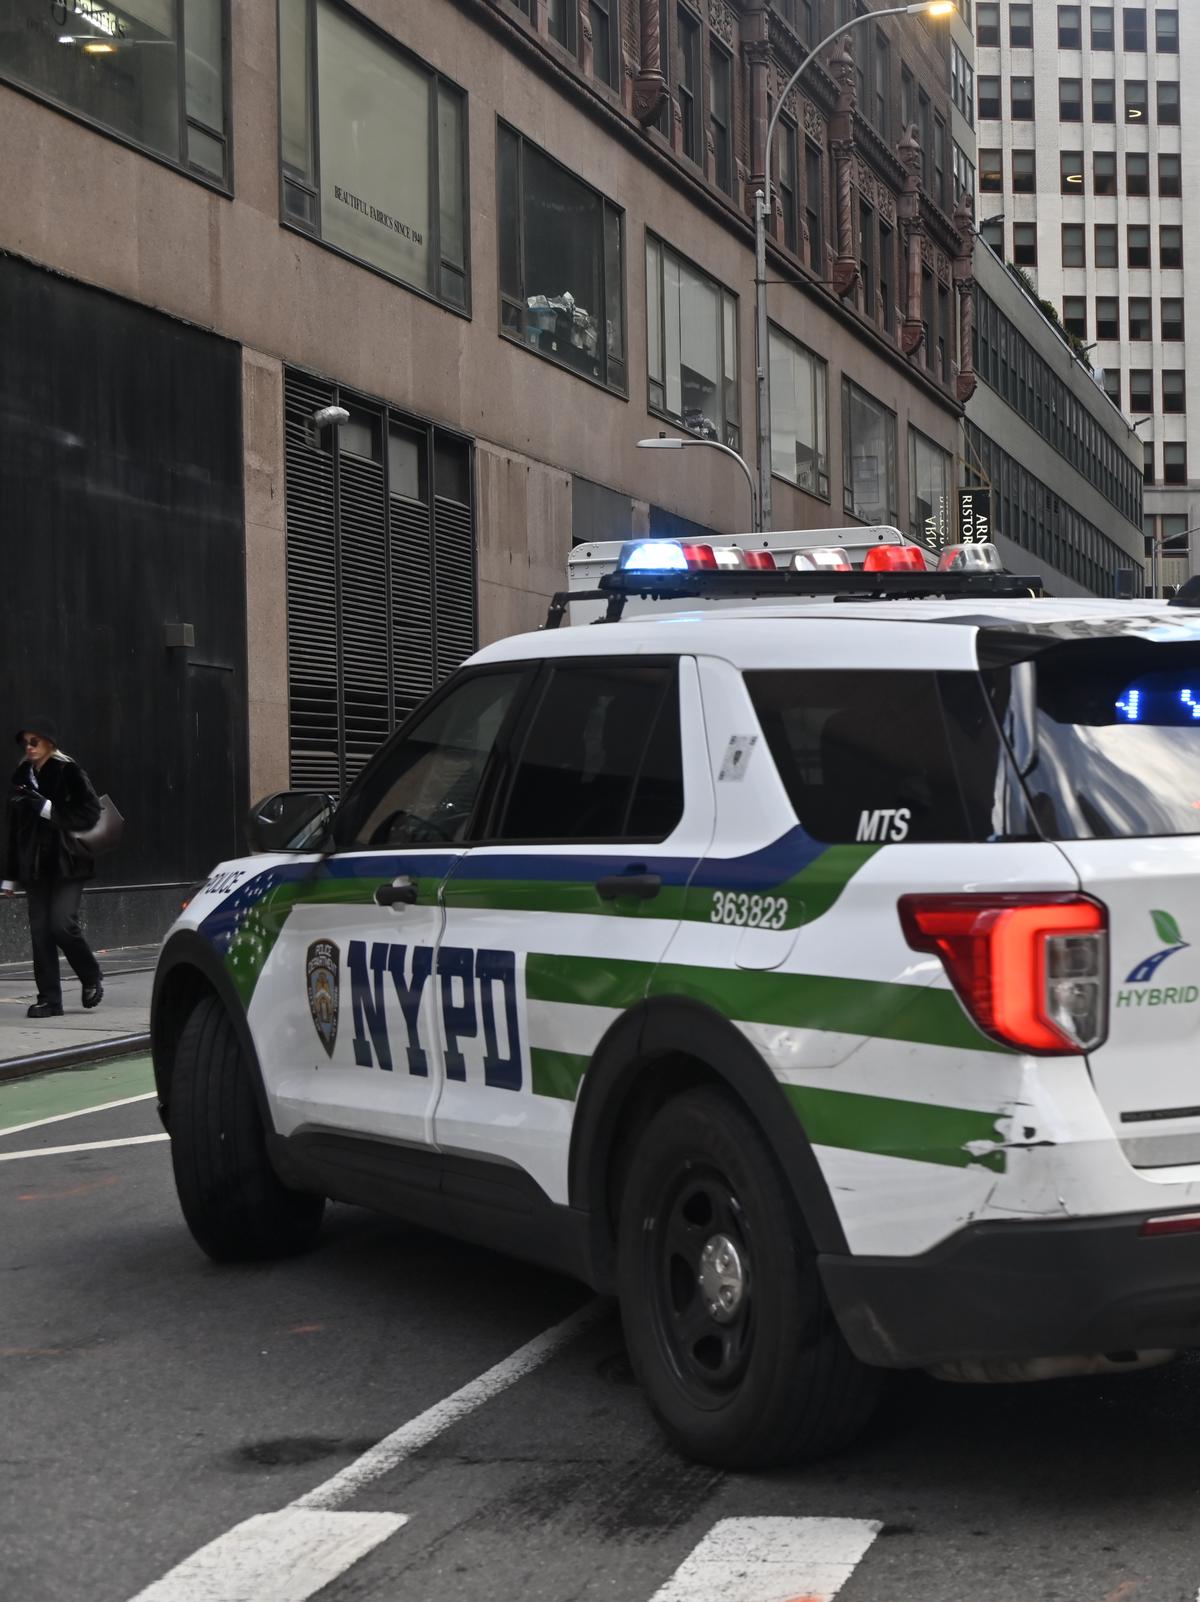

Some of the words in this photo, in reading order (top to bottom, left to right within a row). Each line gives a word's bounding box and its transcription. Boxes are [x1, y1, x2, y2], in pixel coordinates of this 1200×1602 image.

[334, 185, 369, 216] BEAUTIFUL
[369, 206, 394, 230] FABRICS
[394, 220, 411, 240] SINCE
[856, 808, 911, 842] MTS
[711, 890, 788, 930] 363823
[347, 940, 523, 1092] NYPD
[1116, 985, 1199, 1008] HYBRID
